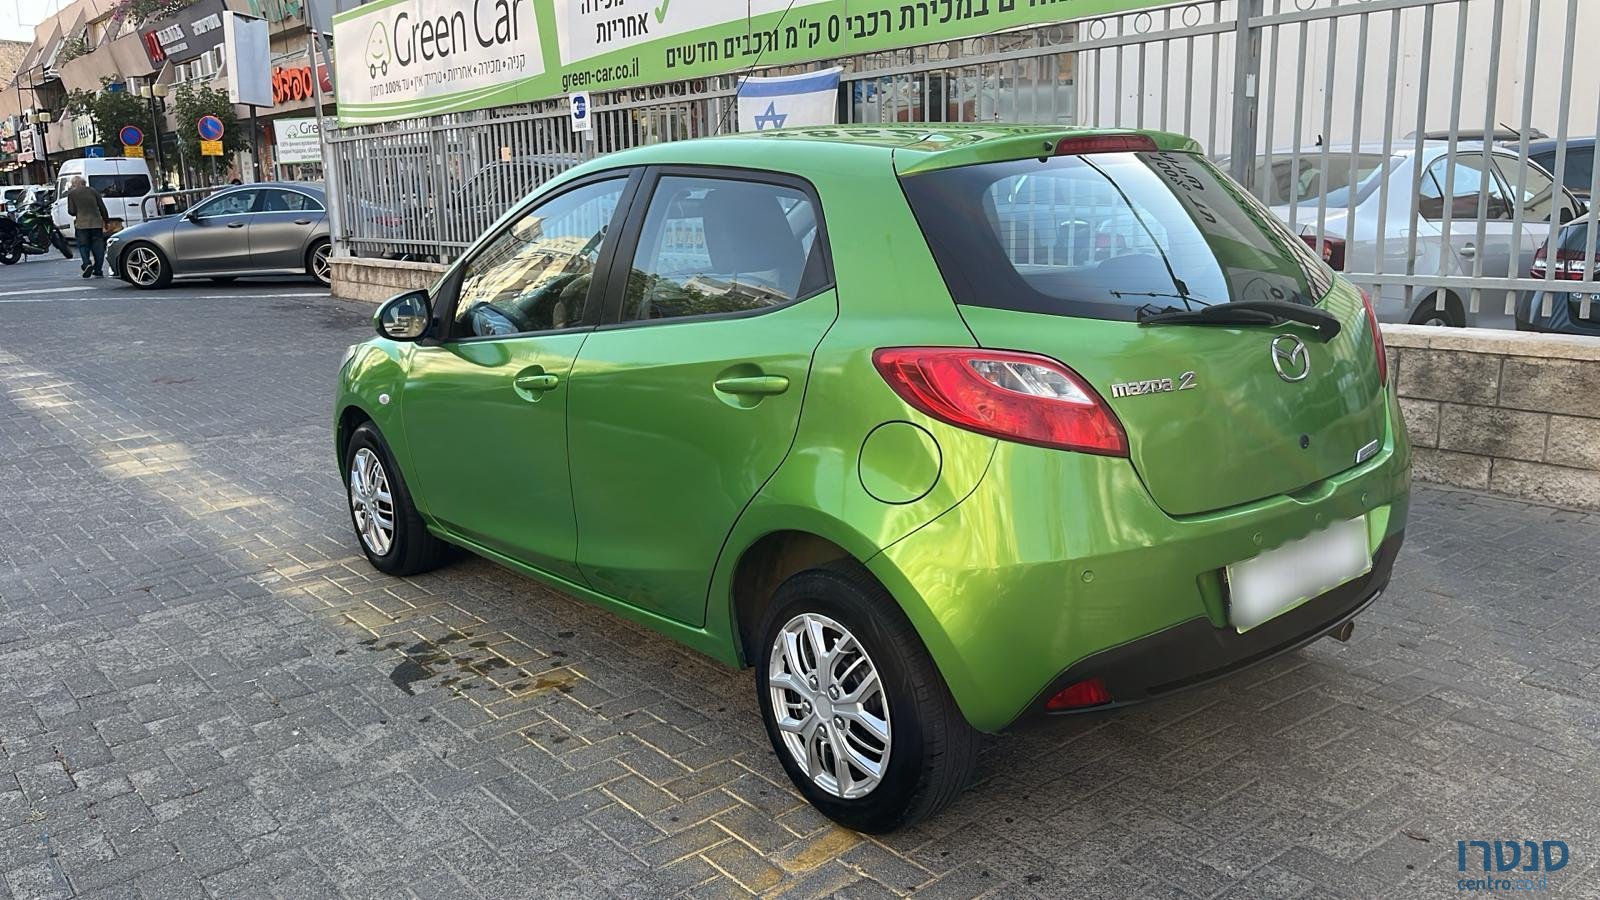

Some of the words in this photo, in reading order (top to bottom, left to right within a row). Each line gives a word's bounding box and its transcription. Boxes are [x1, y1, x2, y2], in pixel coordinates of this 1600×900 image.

[596, 12, 648, 44] אחריות
[826, 14, 841, 42] 0
[846, 8, 892, 39] רכבי
[898, 0, 989, 31] במכירת
[393, 11, 468, 67] Green
[473, 0, 524, 48] Car
[724, 31, 779, 59] ורכבים
[479, 59, 501, 76] מכירה
[508, 54, 526, 72] קניה
[666, 40, 718, 68] חדשים
[385, 80, 402, 94] 100%
[448, 65, 473, 82] אחריות
[561, 57, 640, 92] green-car.co.il
[299, 121, 320, 134] Gre
[1179, 370, 1198, 391] 2
